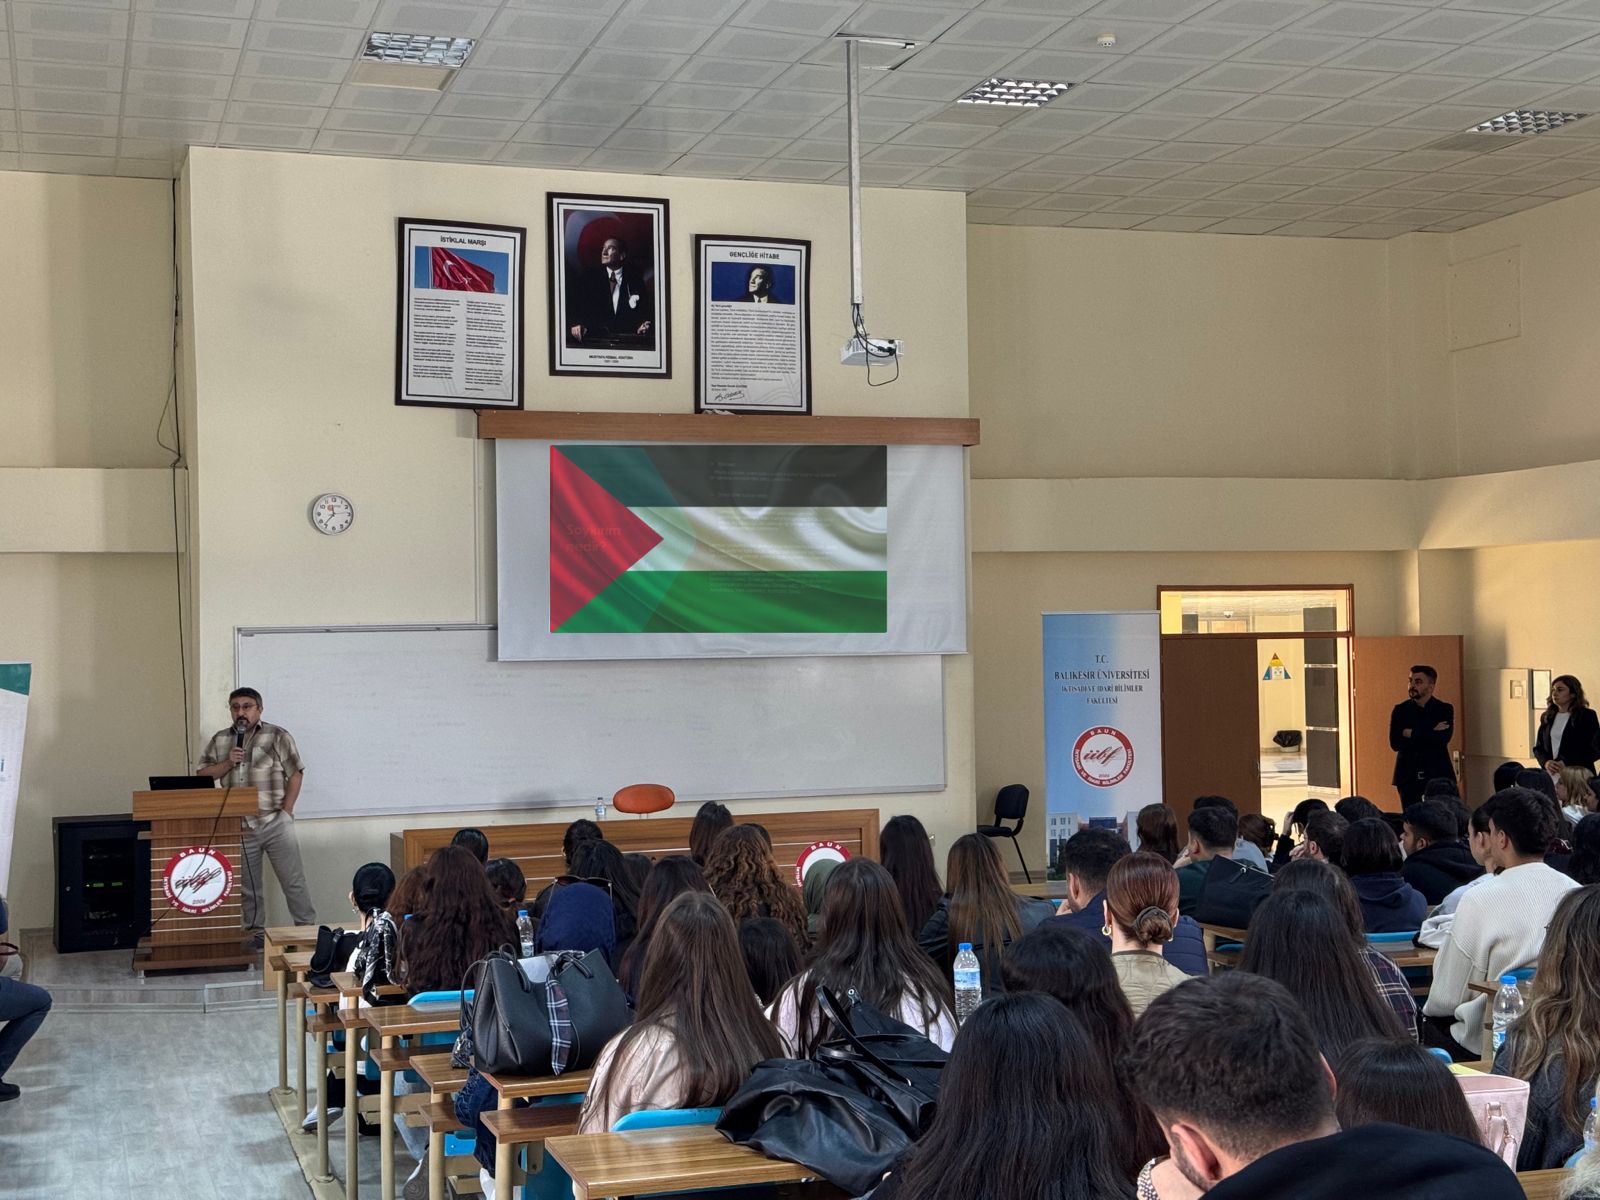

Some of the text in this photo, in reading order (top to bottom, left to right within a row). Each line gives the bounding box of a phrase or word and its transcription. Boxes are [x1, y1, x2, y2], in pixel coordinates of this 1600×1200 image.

[440, 235, 466, 244] İSTİKLAL
[729, 251, 780, 260] GENÇLİĞE HİTABE
[1095, 655, 1109, 664] T.C.
[1054, 668, 1150, 680] BALIKESİR ÜNİVERSİTESİ
[1115, 684, 1144, 692] BİLİMLER
[811, 842, 842, 850] BAUN
[180, 847, 216, 858] BAUN
